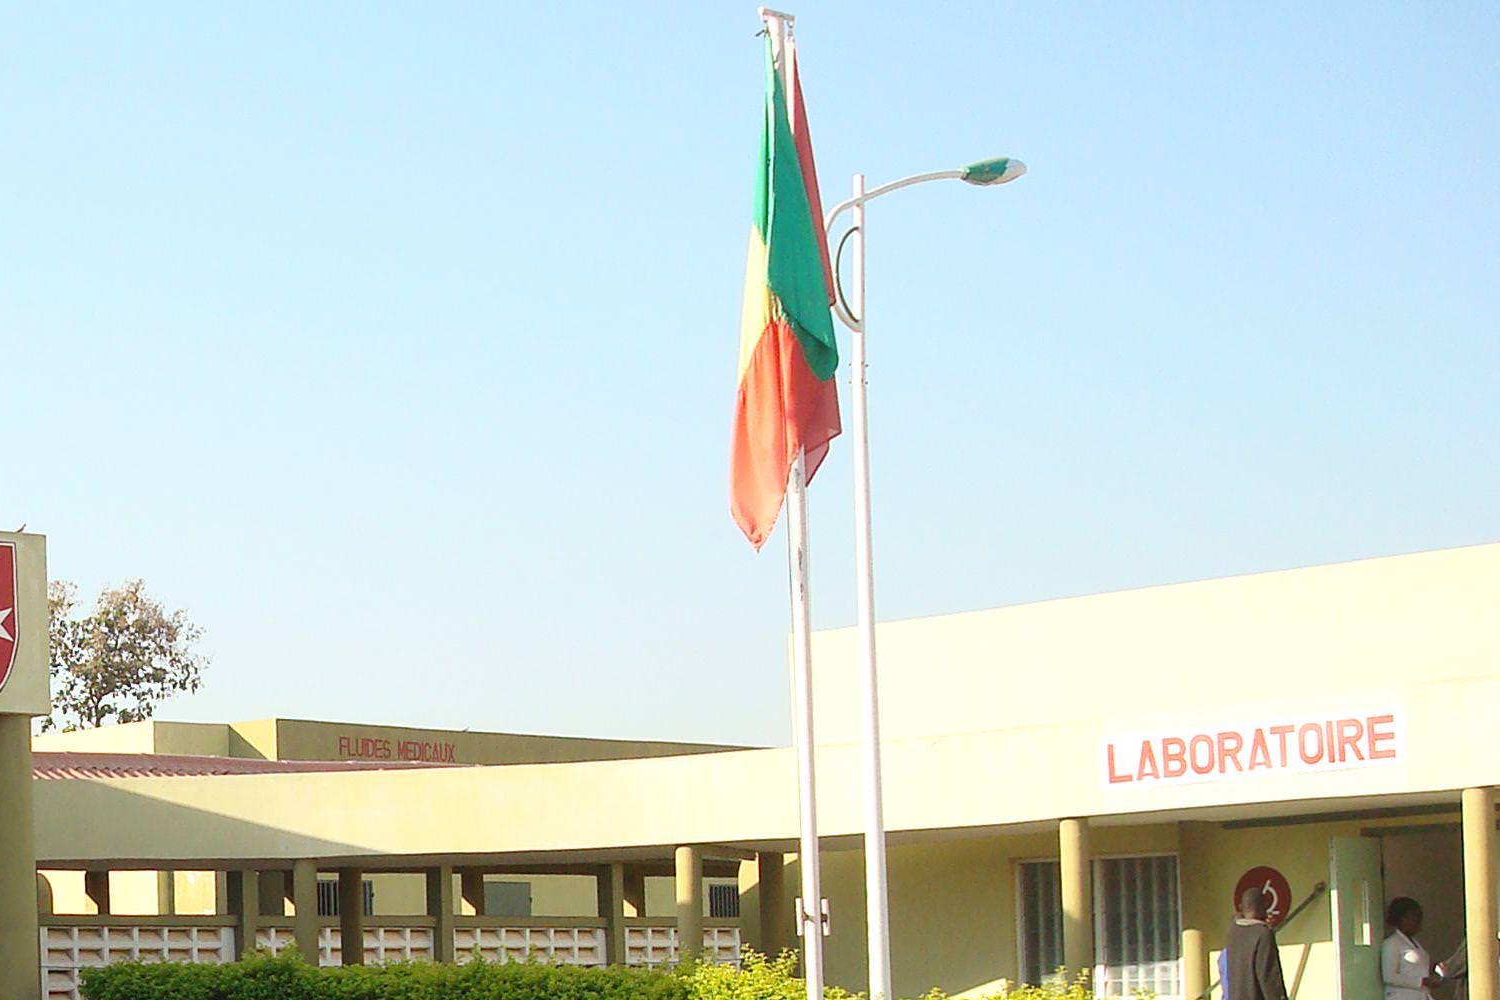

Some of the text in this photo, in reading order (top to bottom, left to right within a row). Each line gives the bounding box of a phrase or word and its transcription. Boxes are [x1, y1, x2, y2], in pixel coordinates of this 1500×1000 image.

[339, 736, 455, 762] FLUIDES MEDICAUX
[1107, 715, 1396, 784] LABORATOIRE
